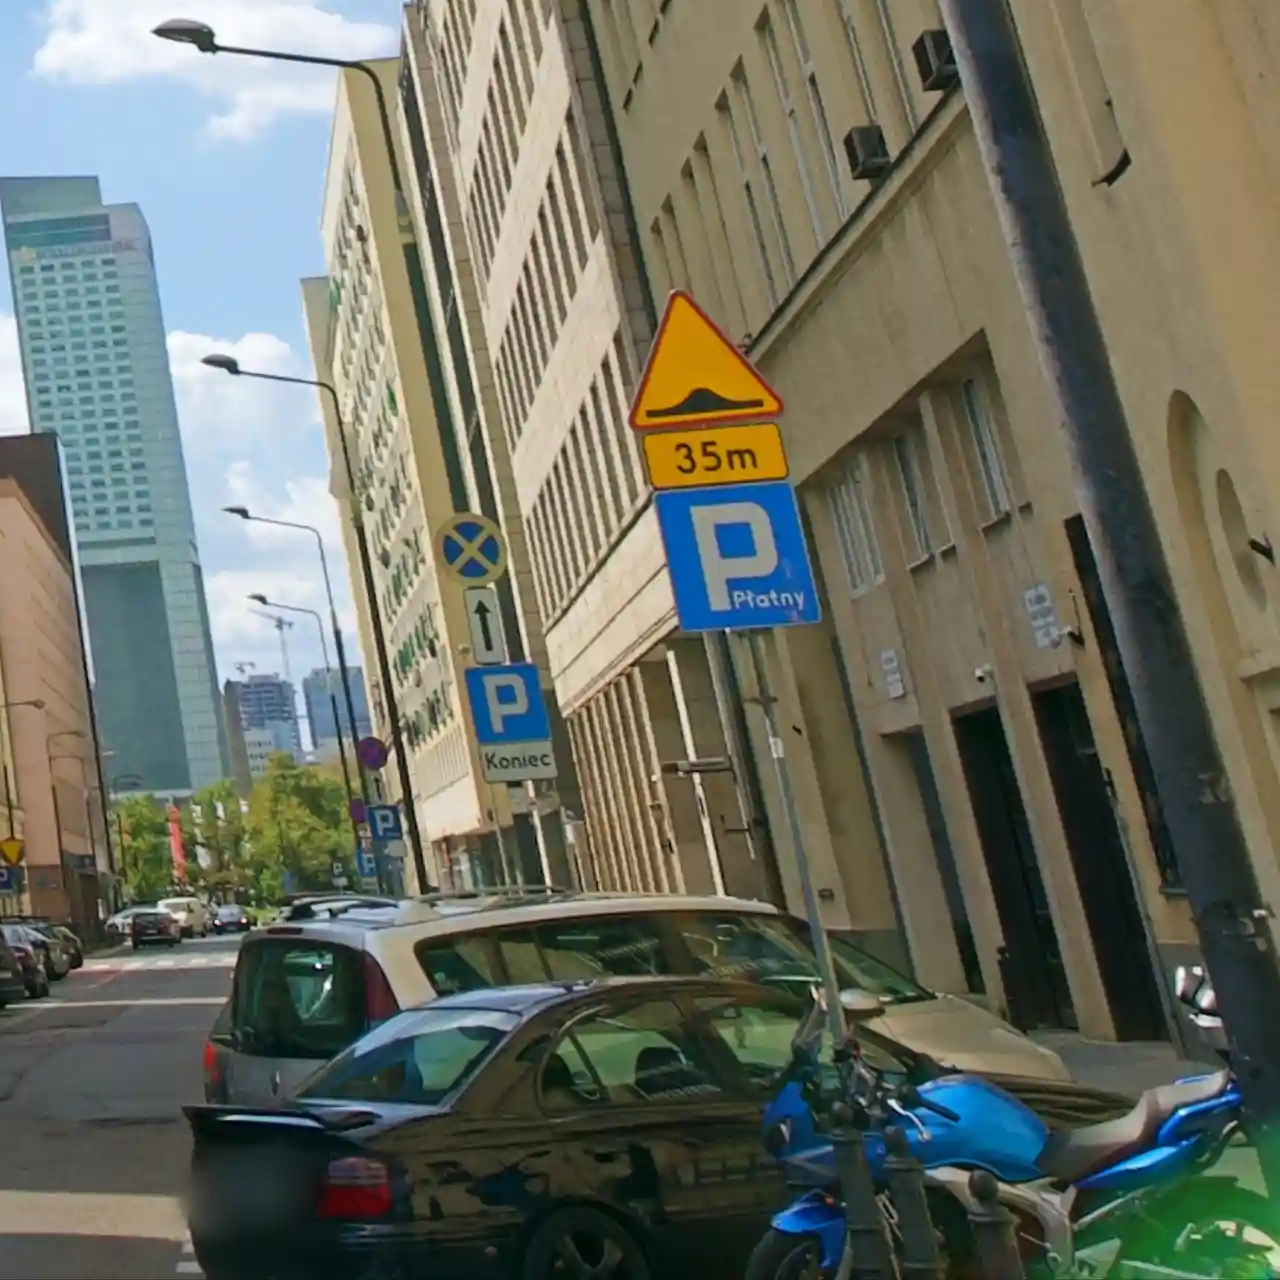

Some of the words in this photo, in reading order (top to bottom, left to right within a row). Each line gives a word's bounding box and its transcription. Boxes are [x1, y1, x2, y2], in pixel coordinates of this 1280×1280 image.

[674, 441, 758, 474] 35m
[690, 502, 778, 612] P
[733, 589, 805, 611] Płatny
[483, 674, 529, 734] P
[485, 752, 552, 770] Koniec
[374, 810, 394, 836] P
